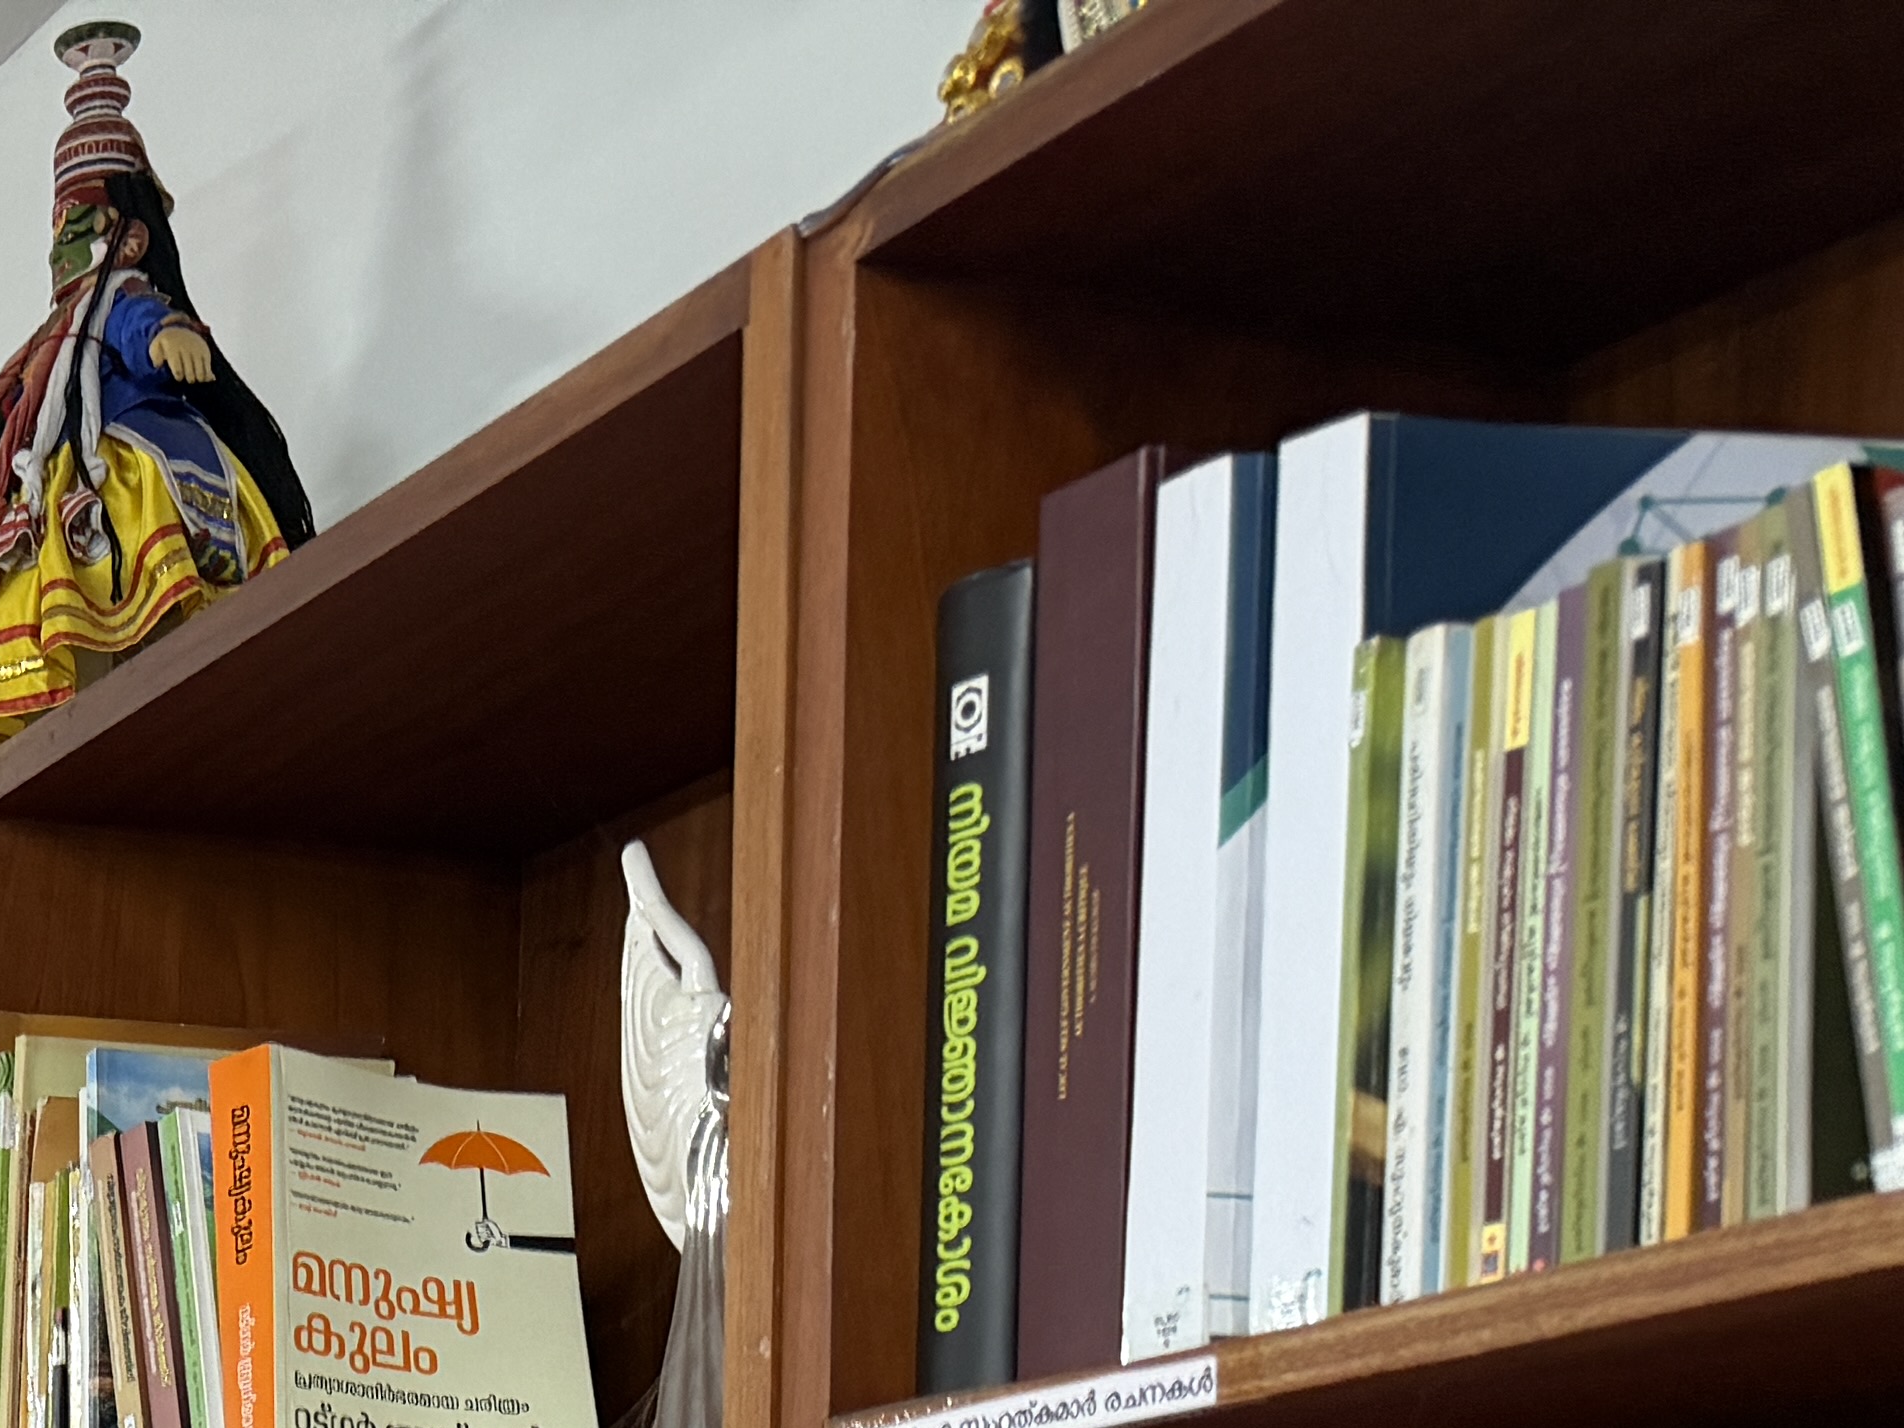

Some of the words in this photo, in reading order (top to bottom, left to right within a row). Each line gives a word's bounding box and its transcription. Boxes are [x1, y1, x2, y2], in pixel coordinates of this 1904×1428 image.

[944, 781, 990, 927] നിയമ
[227, 1104, 254, 1266] മനുഷ്യകുലം
[932, 936, 988, 1333] വിജ്ഞാനകോശം
[291, 1249, 480, 1336] മനുഷ്യ
[293, 1311, 439, 1376] കുലം
[1104, 1365, 1214, 1413] രചനകൾ
